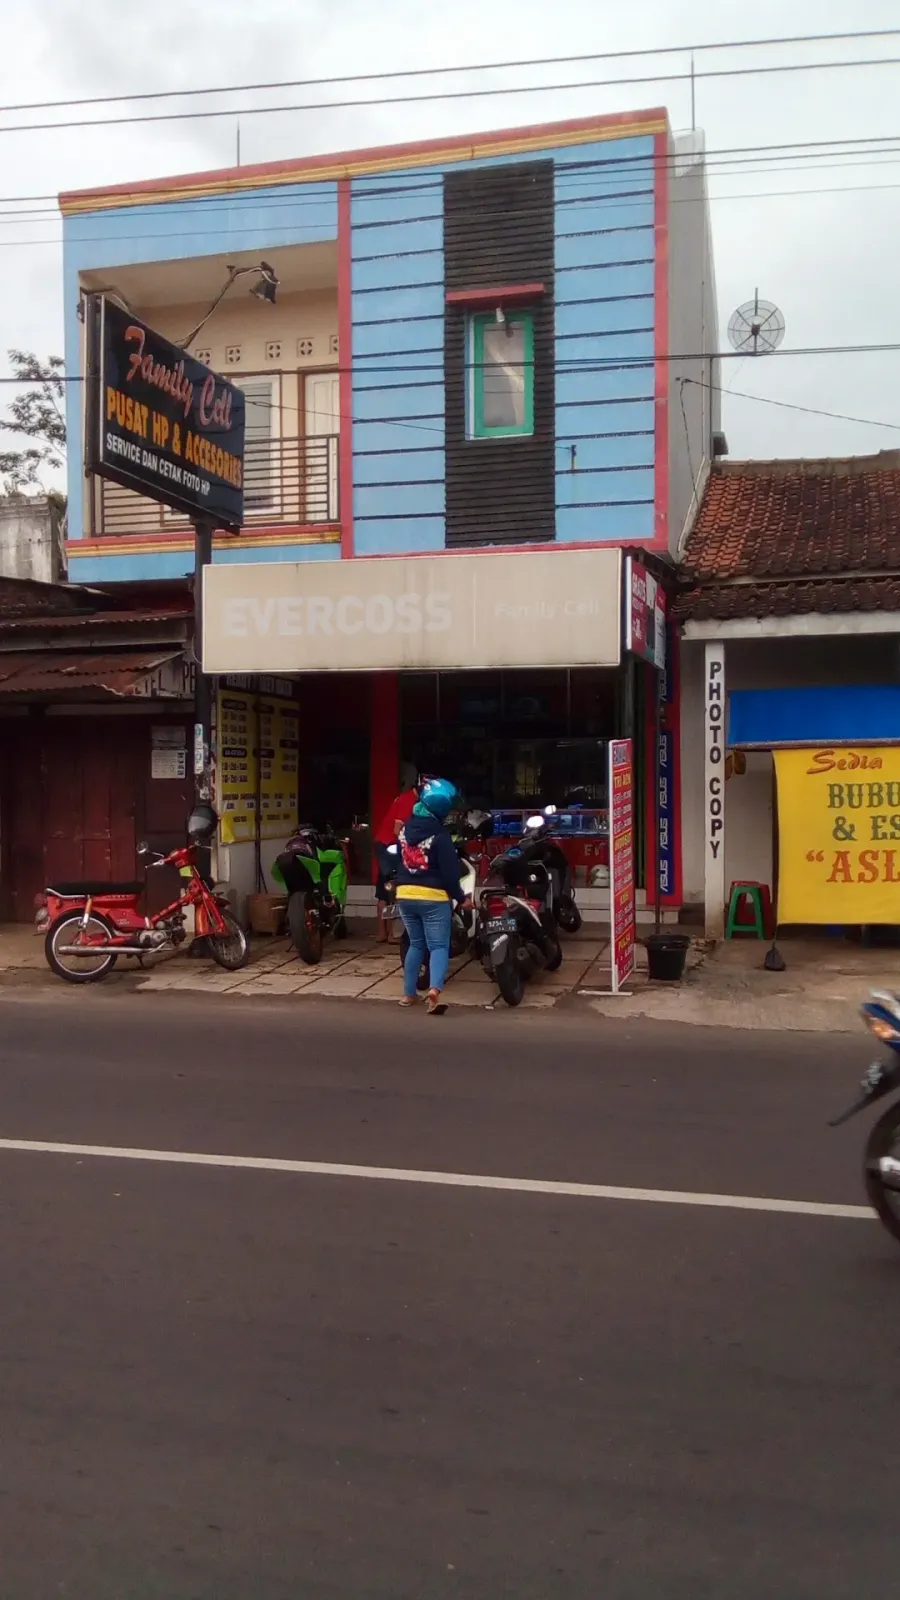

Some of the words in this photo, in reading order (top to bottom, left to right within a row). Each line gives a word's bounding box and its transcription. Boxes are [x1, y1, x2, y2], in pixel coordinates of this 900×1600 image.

[124, 326, 193, 418] Family
[107, 387, 148, 438] PUSAT
[152, 412, 169, 446] HP
[173, 425, 181, 456] &
[185, 431, 243, 489] ACCESORIES
[106, 433, 141, 463] SERVICE
[142, 451, 157, 471] DAN
[159, 457, 182, 484] CETAK
[183, 471, 200, 492] FOTO
[201, 480, 210, 496] HP
[223, 594, 451, 637] EVERCOSS
[495, 600, 557, 620] Family
[565, 599, 599, 616] Cell
[709, 661, 723, 765] PHOTO
[806, 750, 883, 774] Sedia
[826, 782, 900, 809] BUBU
[660, 817, 668, 850] ASUS
[709, 777, 724, 859] COPY
[832, 816, 858, 841] &
[870, 814, 900, 841] ES
[660, 859, 668, 892] ASUS
